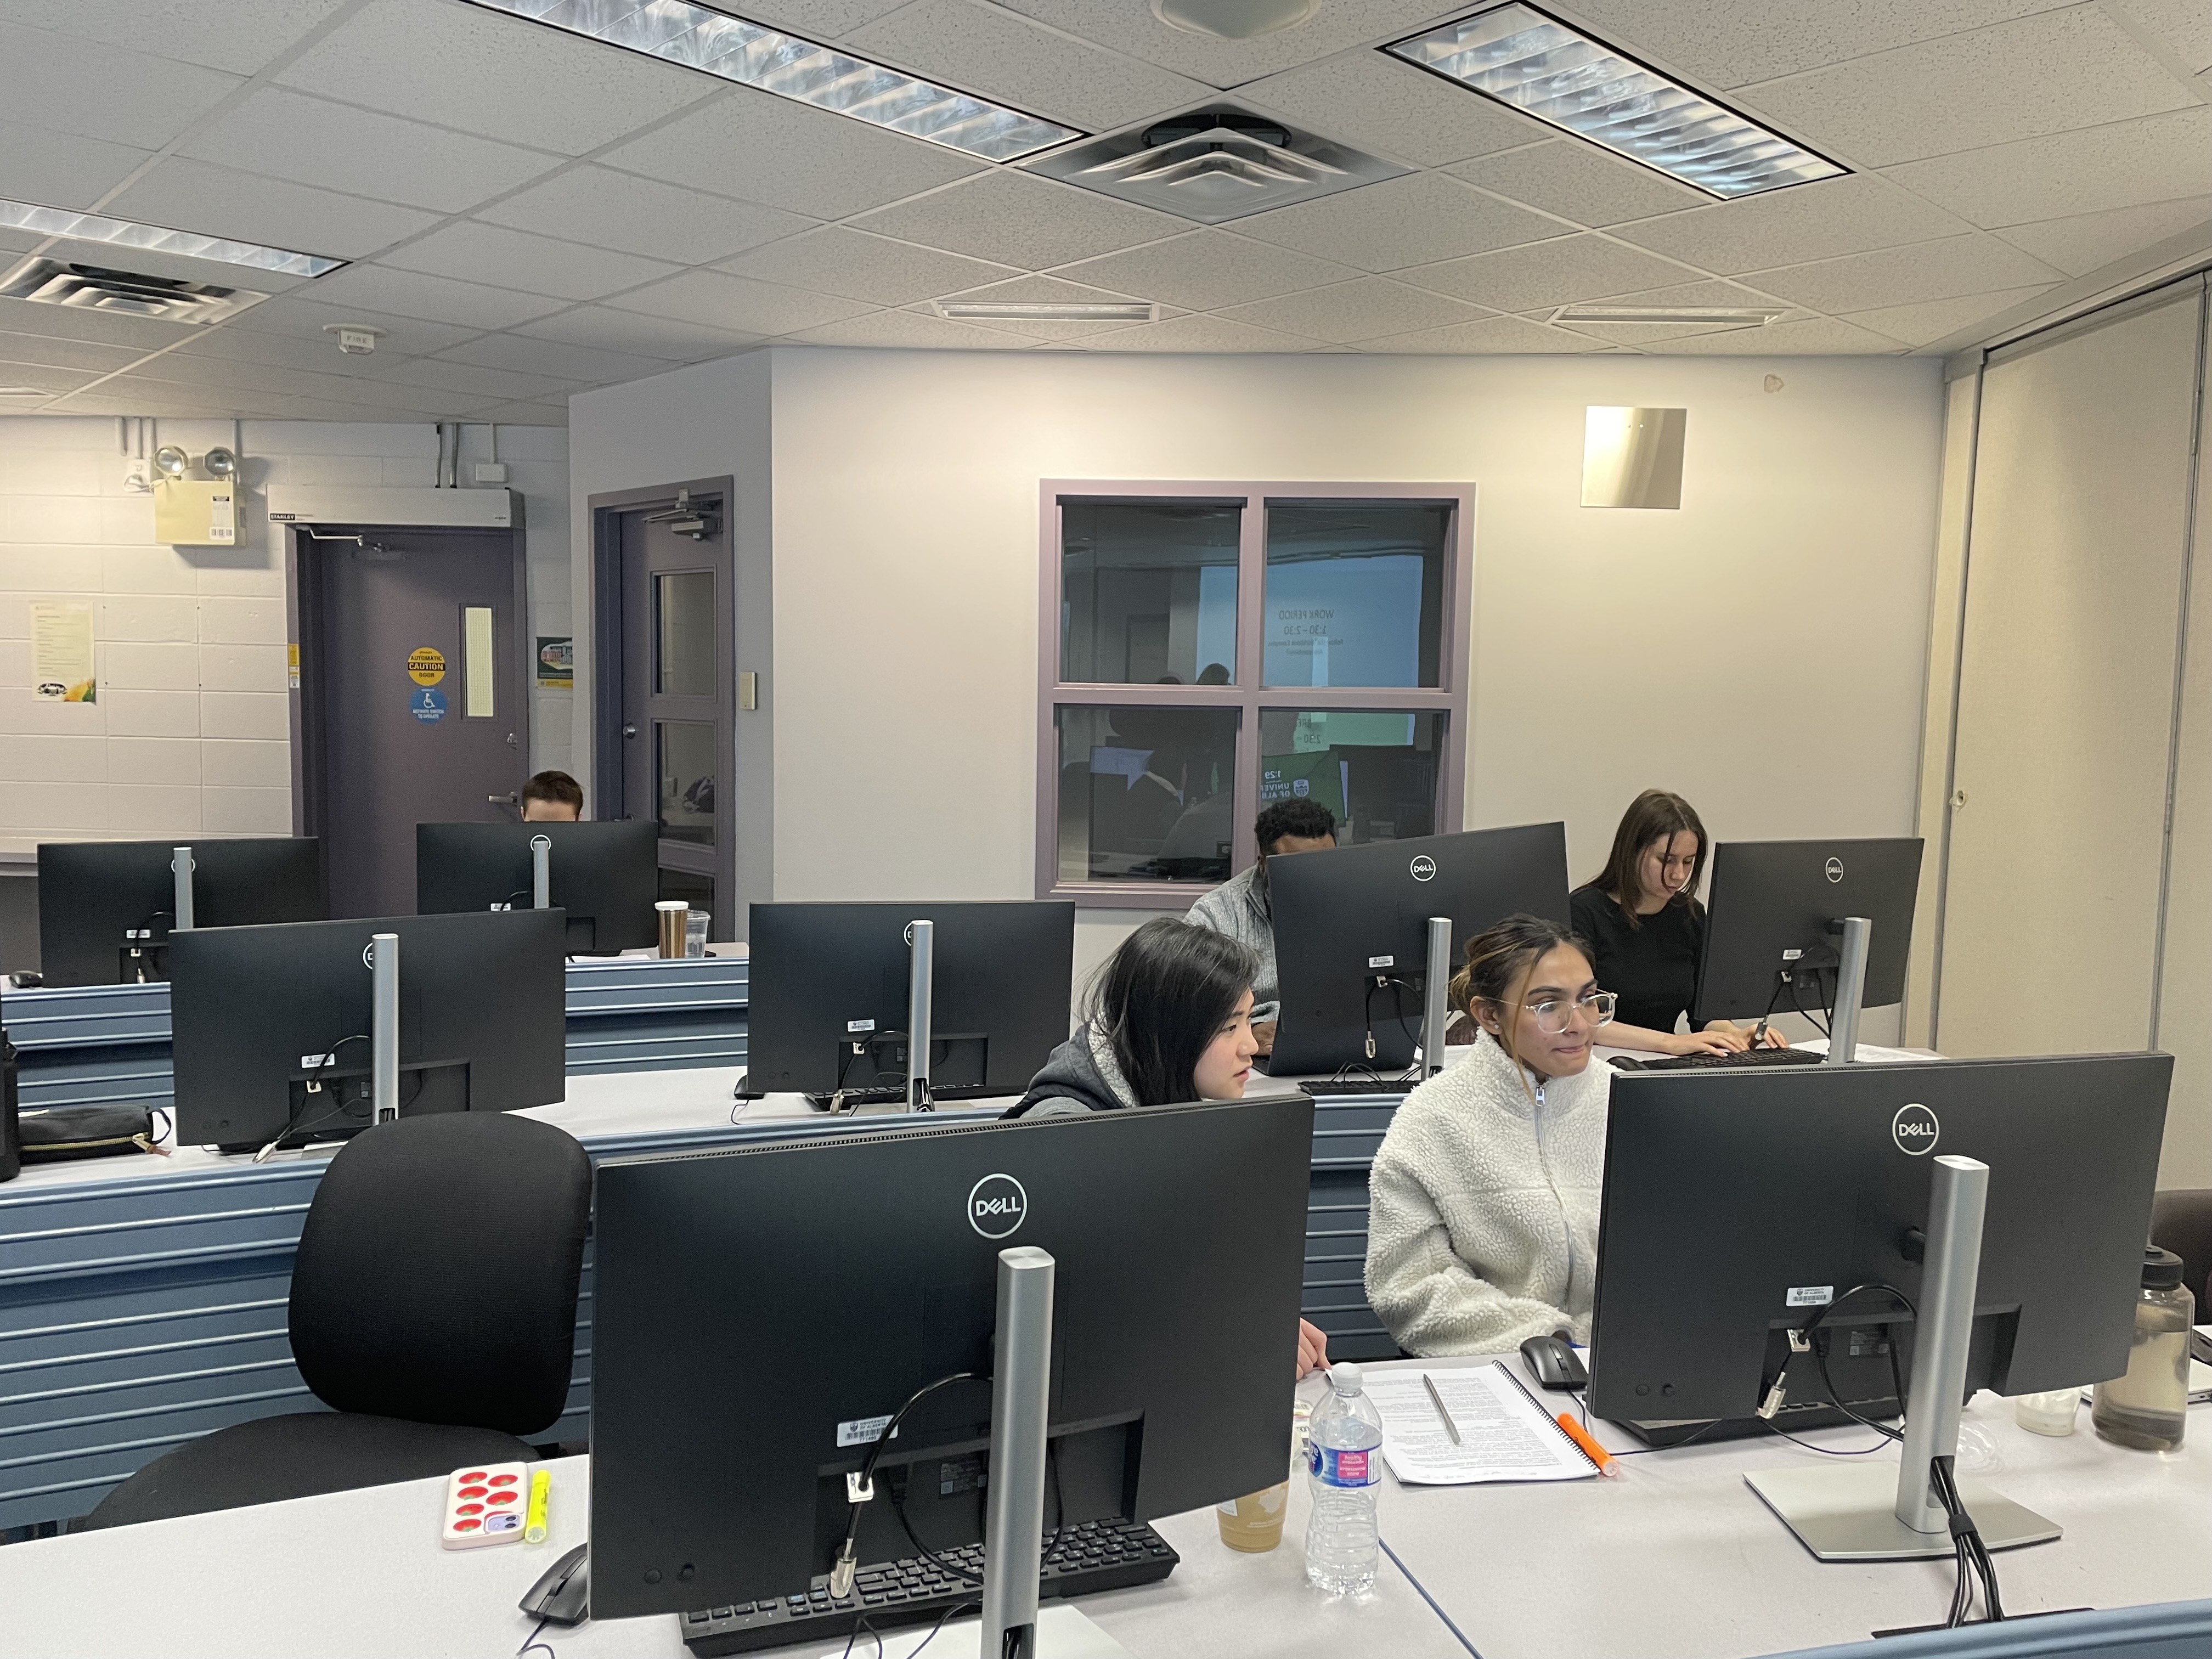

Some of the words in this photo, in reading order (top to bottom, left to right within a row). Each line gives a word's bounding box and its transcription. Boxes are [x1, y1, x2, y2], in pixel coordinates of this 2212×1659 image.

[347, 335, 367, 343] FIRE
[1414, 864, 1433, 872] DELL
[1899, 1123, 1934, 1136] DELL
[976, 1197, 1020, 1216] DELL
